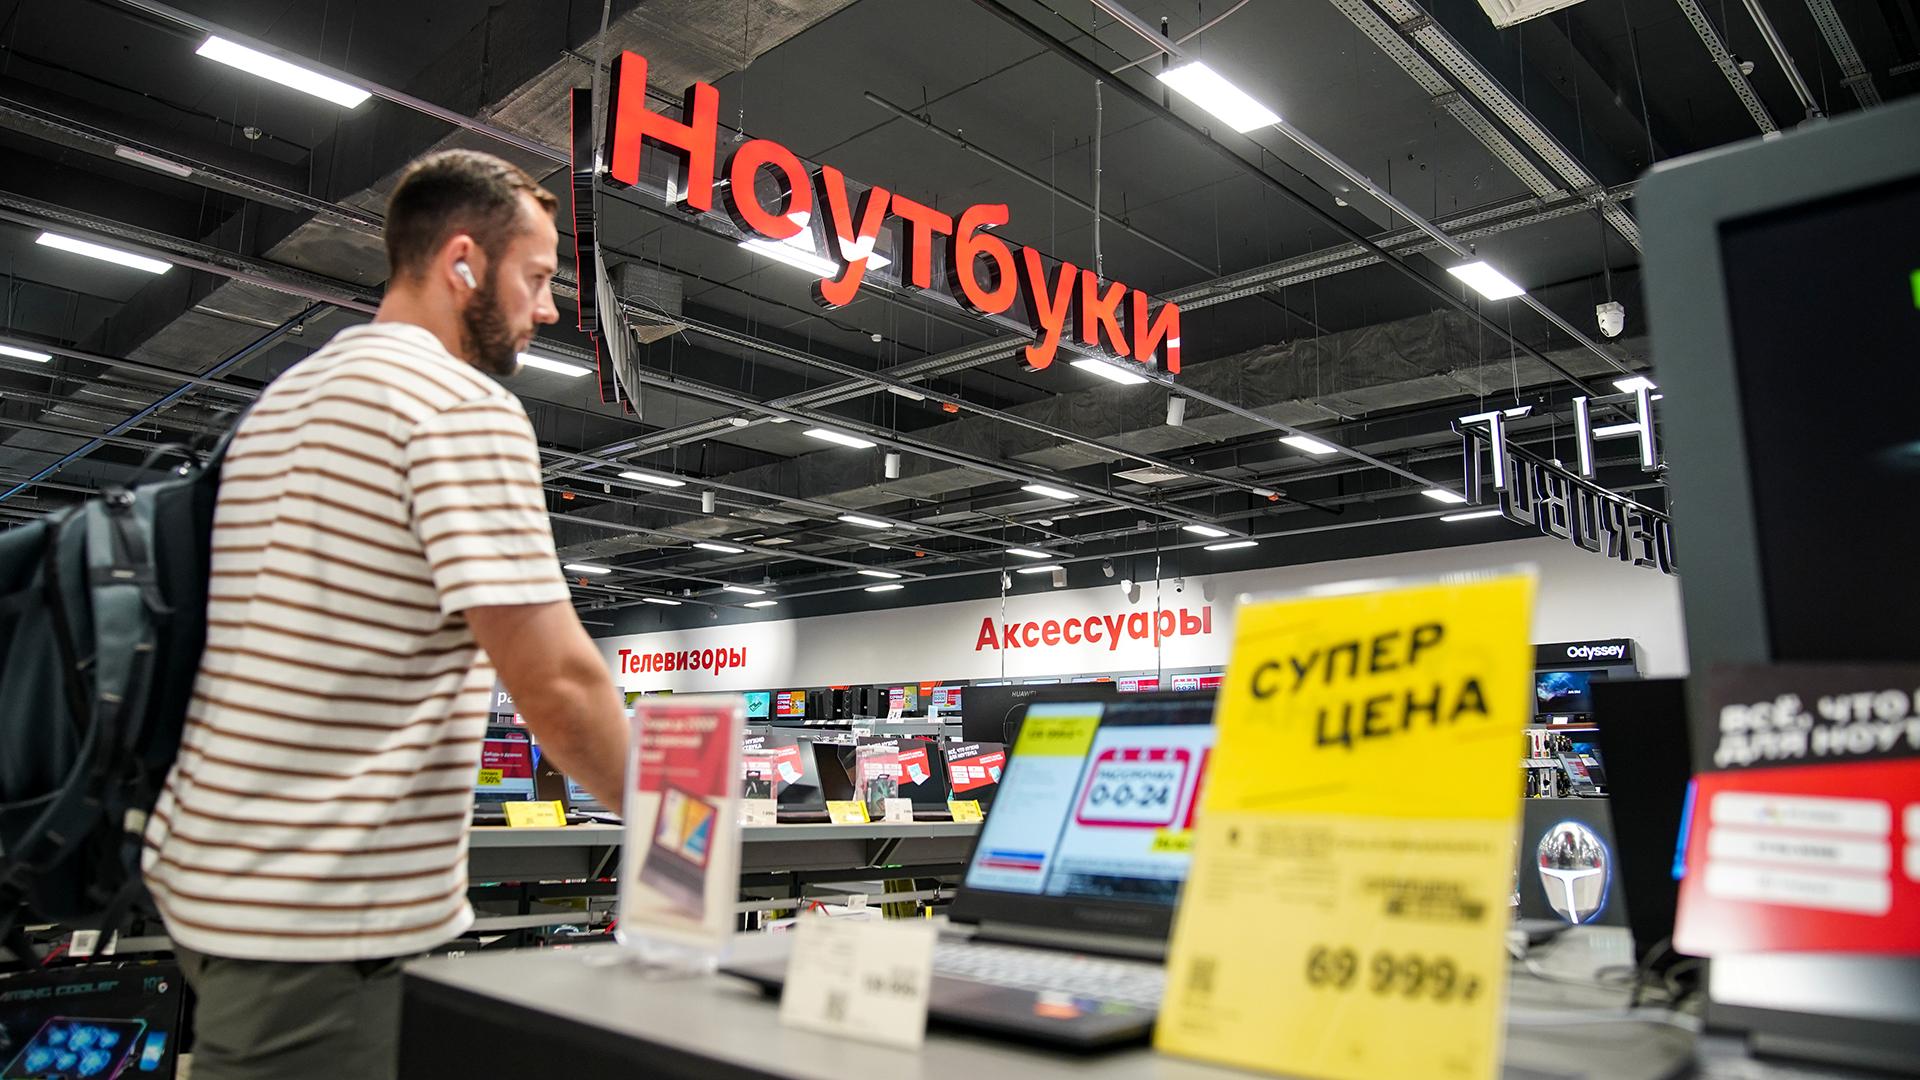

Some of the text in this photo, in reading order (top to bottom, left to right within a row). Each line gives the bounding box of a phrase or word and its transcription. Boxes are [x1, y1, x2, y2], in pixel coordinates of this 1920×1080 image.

[609, 49, 1182, 376] Ноутбуки
[975, 605, 1213, 651] Аксессуары
[618, 645, 747, 675] Телевизоры
[1250, 621, 1446, 699] СУПЕР
[1566, 644, 1625, 661] Odyssey
[1314, 680, 1490, 750] ЦЕНА
[1306, 943, 1360, 988] 69
